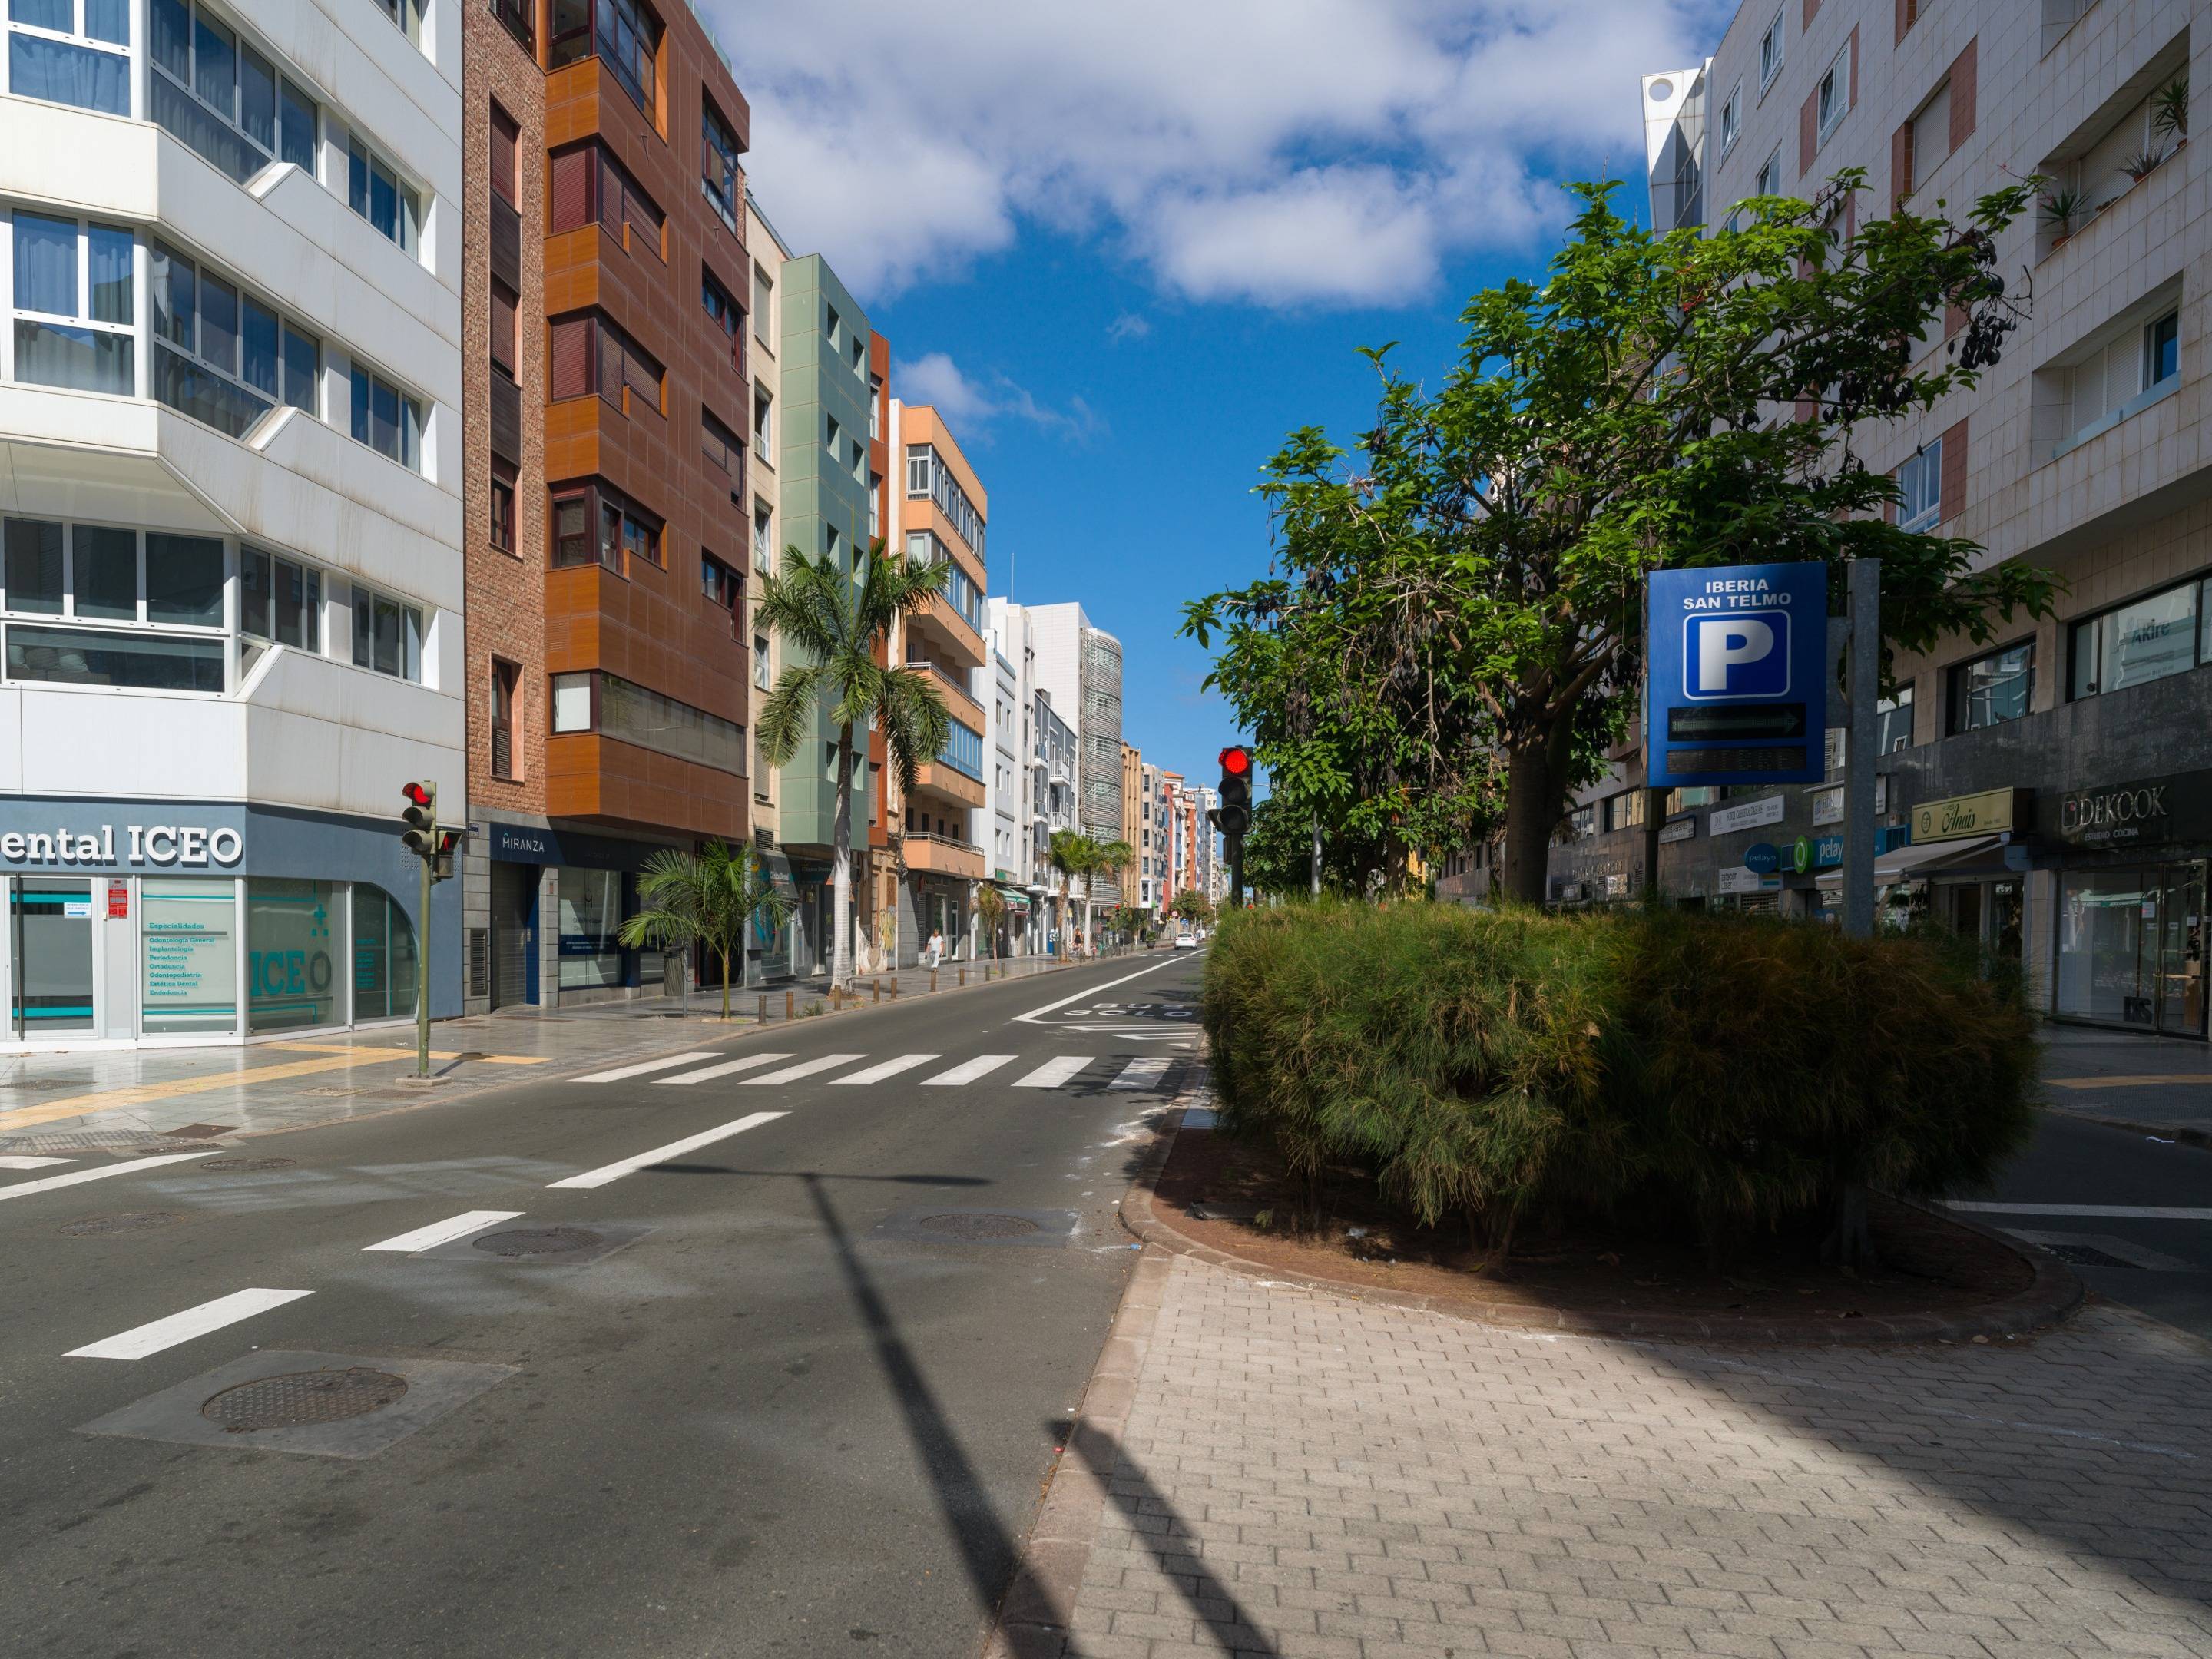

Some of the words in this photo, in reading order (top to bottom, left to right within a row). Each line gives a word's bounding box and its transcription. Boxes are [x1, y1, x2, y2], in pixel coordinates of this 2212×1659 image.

[1706, 579, 1770, 594] IBERIA
[1683, 597, 1721, 610] SAN
[1727, 592, 1792, 608] TELMO
[1699, 619, 1774, 691] P
[2079, 786, 2168, 826] DEKOOK
[1942, 803, 1975, 833] Anaïs
[2113, 828, 2138, 838] COCINA
[128, 826, 242, 863] ICEO
[502, 835, 545, 853] MIRANZA
[1820, 839, 1843, 864] pelay
[1748, 853, 1776, 863] pelayo
[250, 950, 332, 996] ICEO
[1063, 1009, 1193, 1018] SOLO
